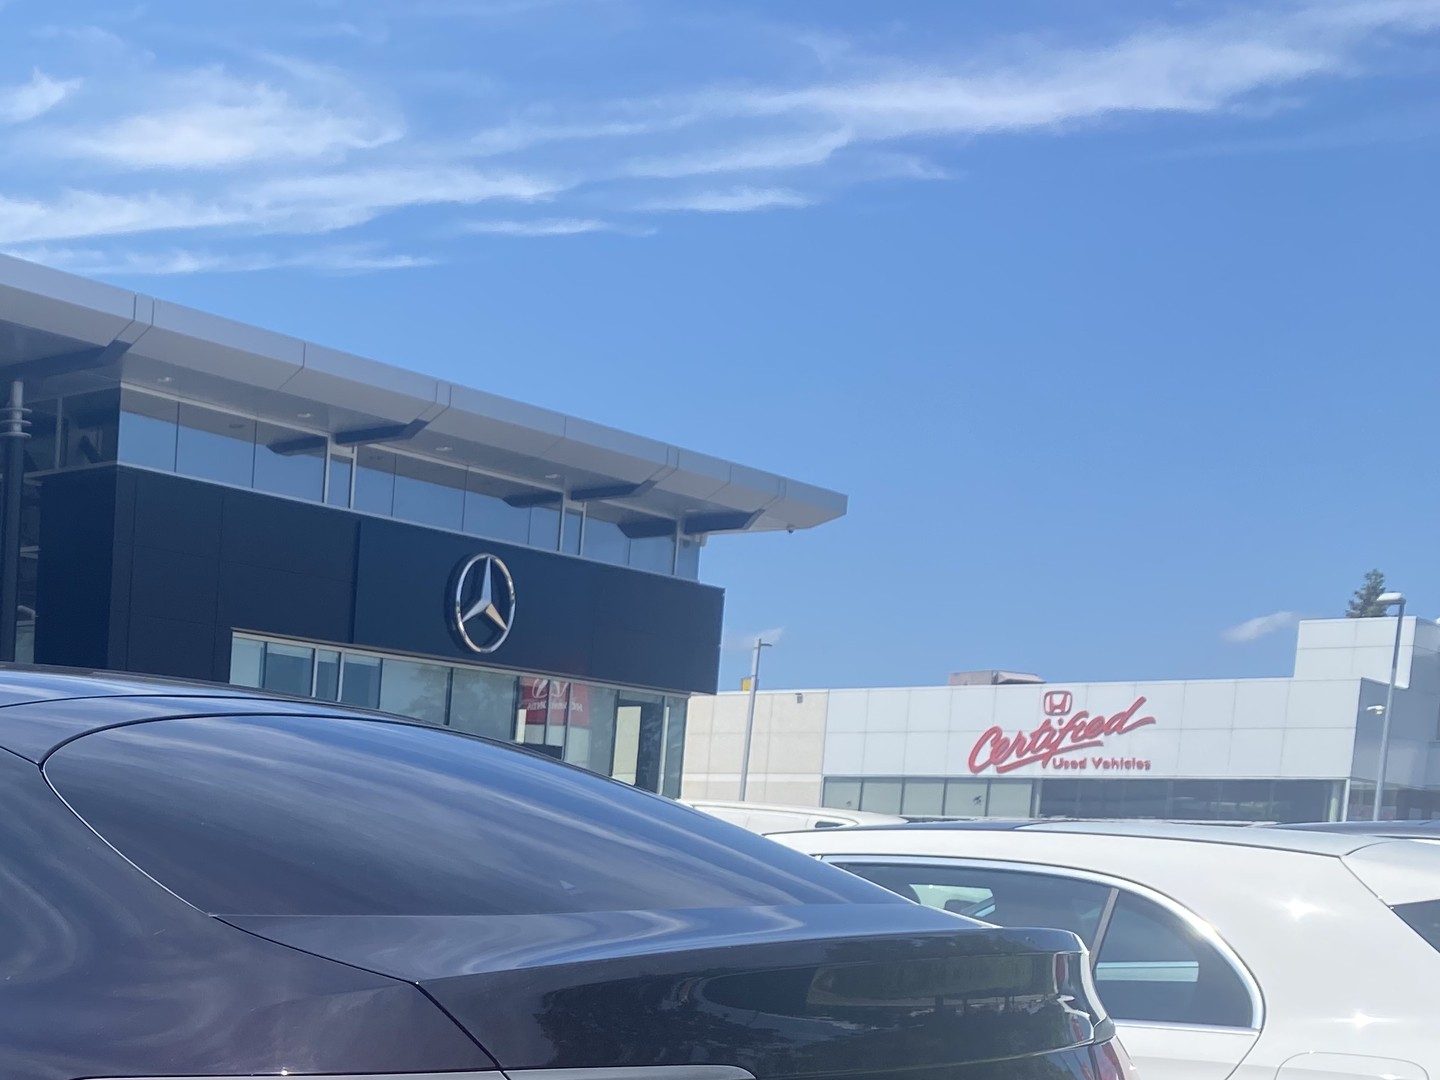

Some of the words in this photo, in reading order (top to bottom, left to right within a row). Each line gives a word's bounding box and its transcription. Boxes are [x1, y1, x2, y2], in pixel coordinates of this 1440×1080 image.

[968, 696, 1156, 774] Certified
[1053, 757, 1087, 770] Used
[1092, 757, 1151, 771] Vehicles
